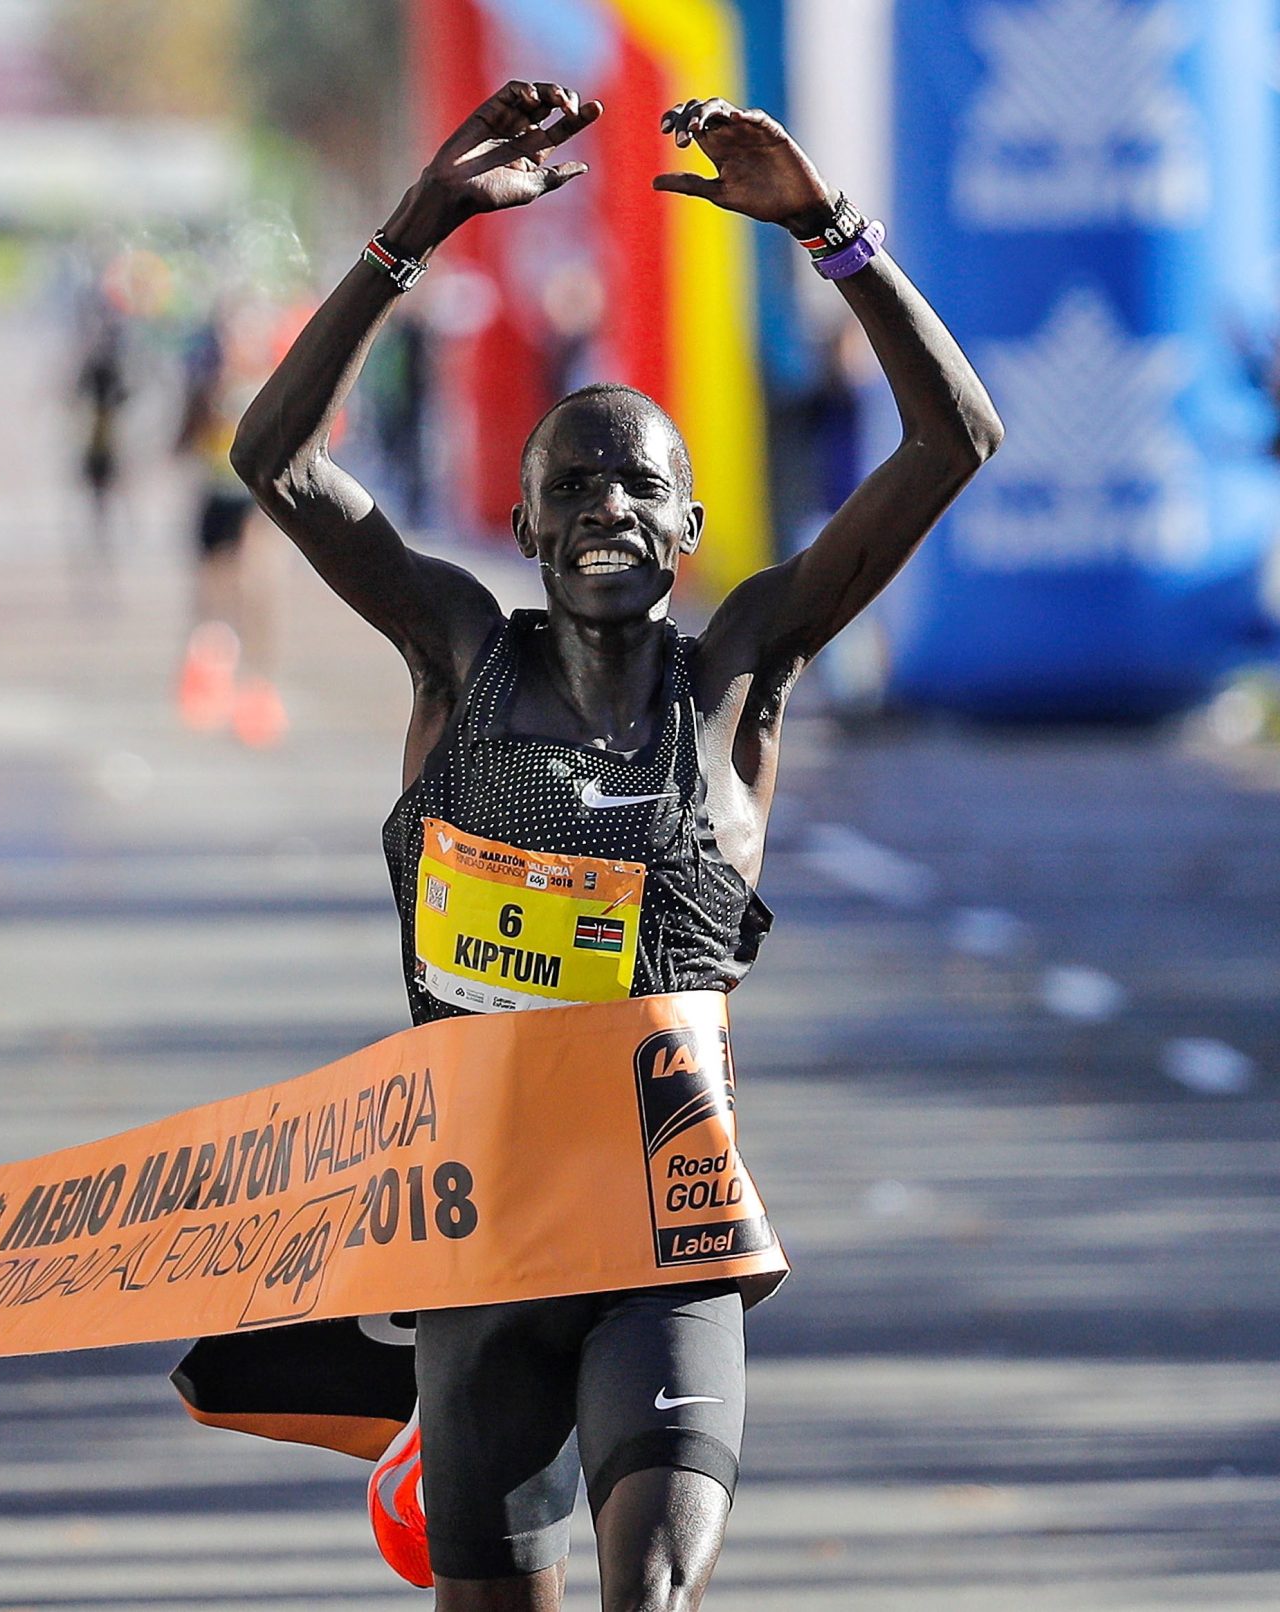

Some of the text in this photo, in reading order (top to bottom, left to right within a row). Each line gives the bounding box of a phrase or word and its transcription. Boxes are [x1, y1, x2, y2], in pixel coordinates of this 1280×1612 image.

[455, 842, 570, 877] MEDIO MARATÓN VALENCIA
[485, 862, 526, 878] ALFONSO
[550, 877, 573, 888] 2018
[499, 904, 523, 938] 6
[453, 934, 562, 988] KIPTUM
[118, 1102, 302, 1229] MARATÓN
[304, 1067, 437, 1183] VALENCIA
[666, 1149, 729, 1179] Road
[342, 1161, 479, 1249] 2018
[666, 1177, 743, 1212] GOLD
[93, 1209, 281, 1291] ALFONSO
[264, 1206, 332, 1305] edp
[671, 1227, 736, 1257] Label
